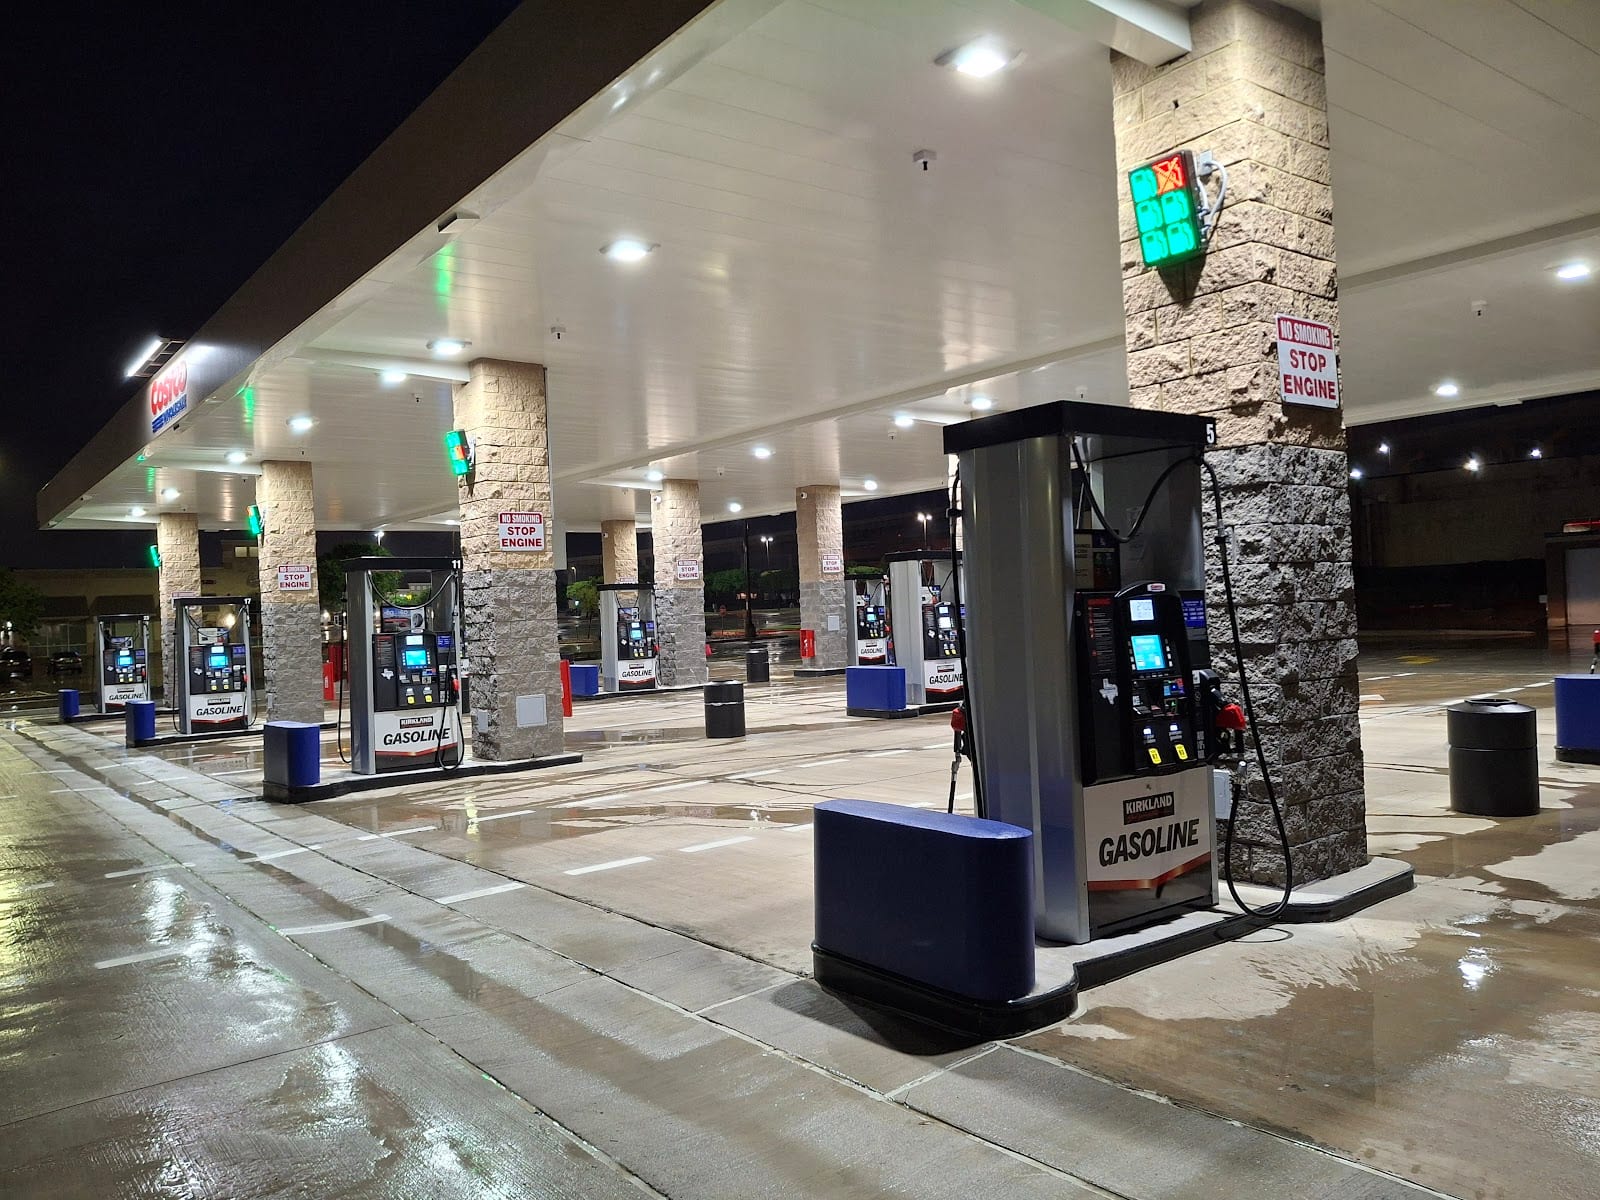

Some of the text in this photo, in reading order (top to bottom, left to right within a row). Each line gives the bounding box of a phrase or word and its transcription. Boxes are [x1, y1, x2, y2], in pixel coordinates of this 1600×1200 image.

[1281, 320, 1330, 346] NO SMOKING
[1290, 348, 1326, 372] STOP
[151, 360, 188, 416] COSTCO
[1283, 373, 1337, 400] ENGINE
[1206, 423, 1215, 444] 5
[501, 514, 541, 524] NO SMOKING
[507, 526, 536, 536] STOP
[501, 538, 542, 547] ENGINE
[451, 559, 461, 569] 11
[621, 669, 653, 678] GASOLINE
[929, 673, 964, 685] GASOLINE
[108, 692, 145, 701] GASOLINE
[196, 705, 243, 716] GASOLINE
[400, 717, 433, 726] KIRKLAND
[383, 727, 451, 746] GASOLINE
[1125, 795, 1173, 815] KIRKLAND
[1098, 818, 1200, 867] GASOLINE
